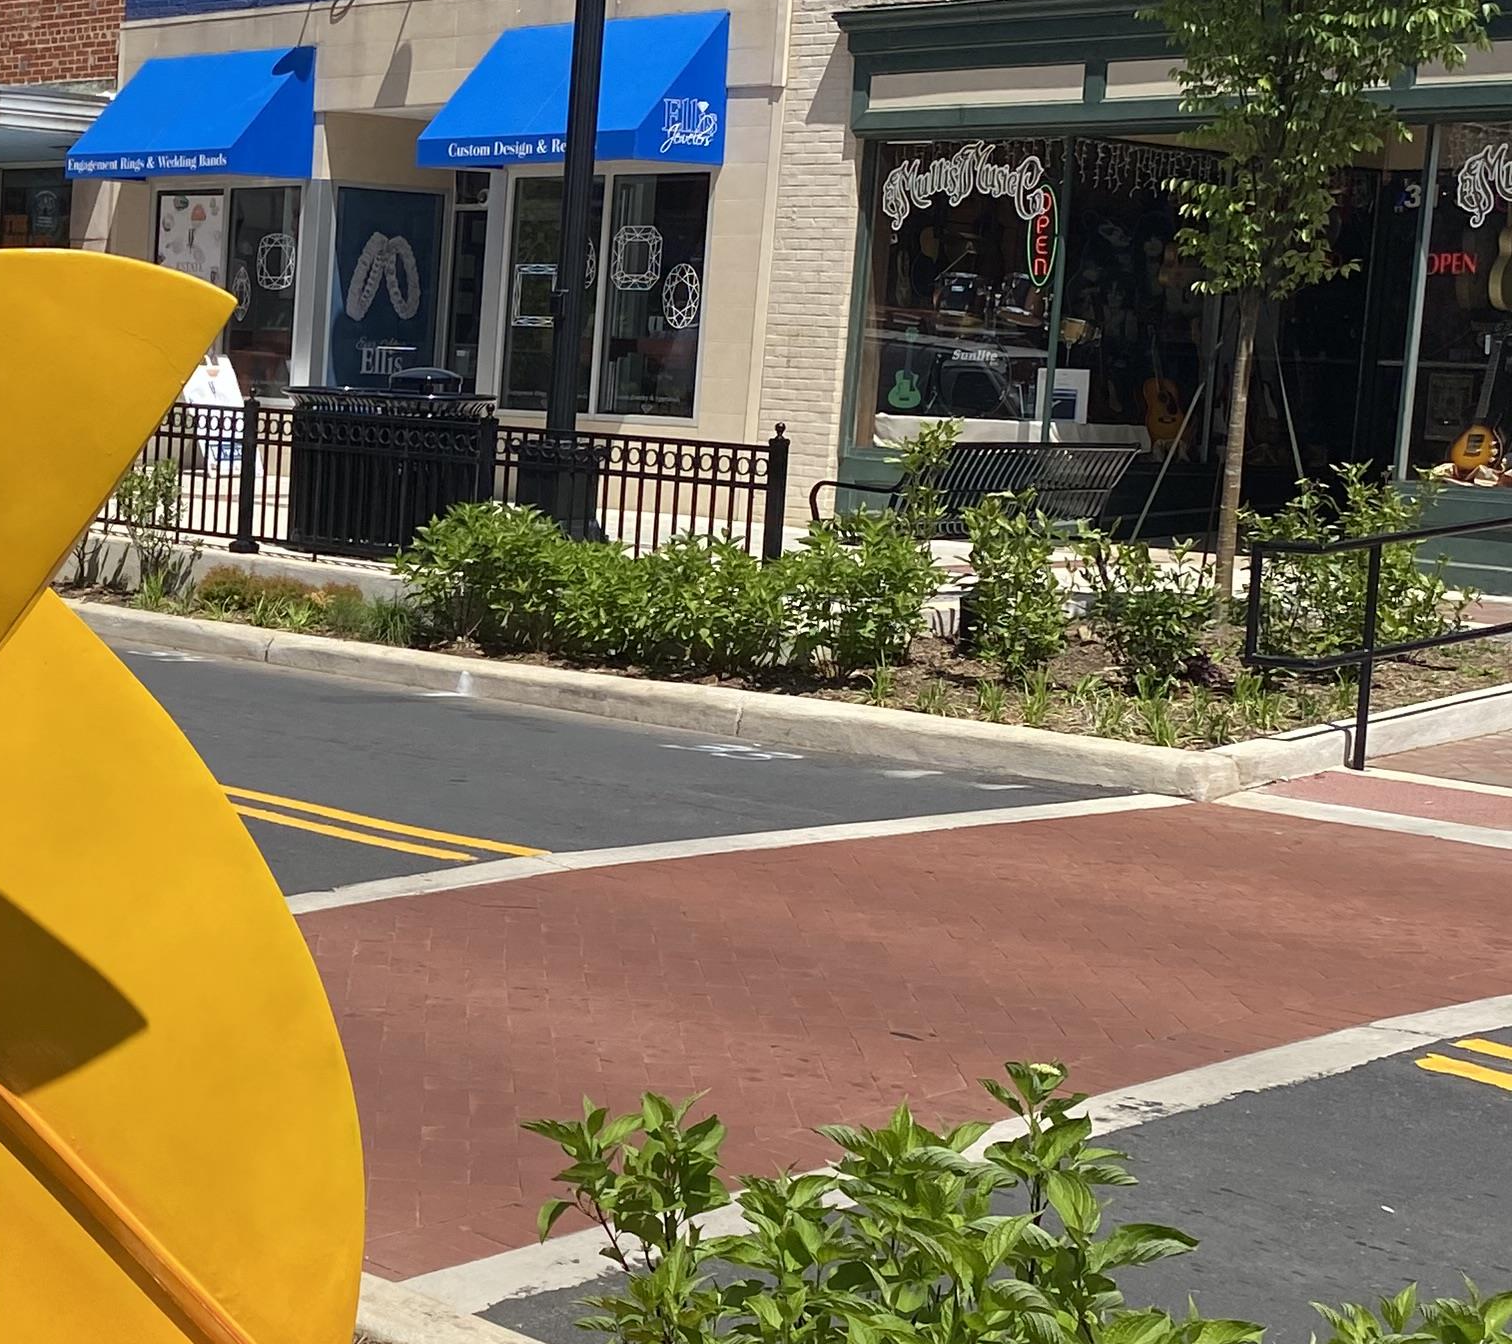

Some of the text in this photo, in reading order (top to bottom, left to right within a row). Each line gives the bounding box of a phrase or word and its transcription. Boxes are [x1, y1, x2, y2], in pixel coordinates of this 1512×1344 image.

[661, 97, 718, 136] Ellis
[448, 142, 490, 157] Custom
[493, 141, 533, 158] Design
[536, 138, 547, 154] &
[67, 153, 227, 173] Engagement Rings & Wedding Bands
[947, 140, 1018, 207] Music
[1033, 192, 1052, 276] OPEN
[360, 348, 403, 374] Ellis
[951, 349, 998, 362] Sunlite
